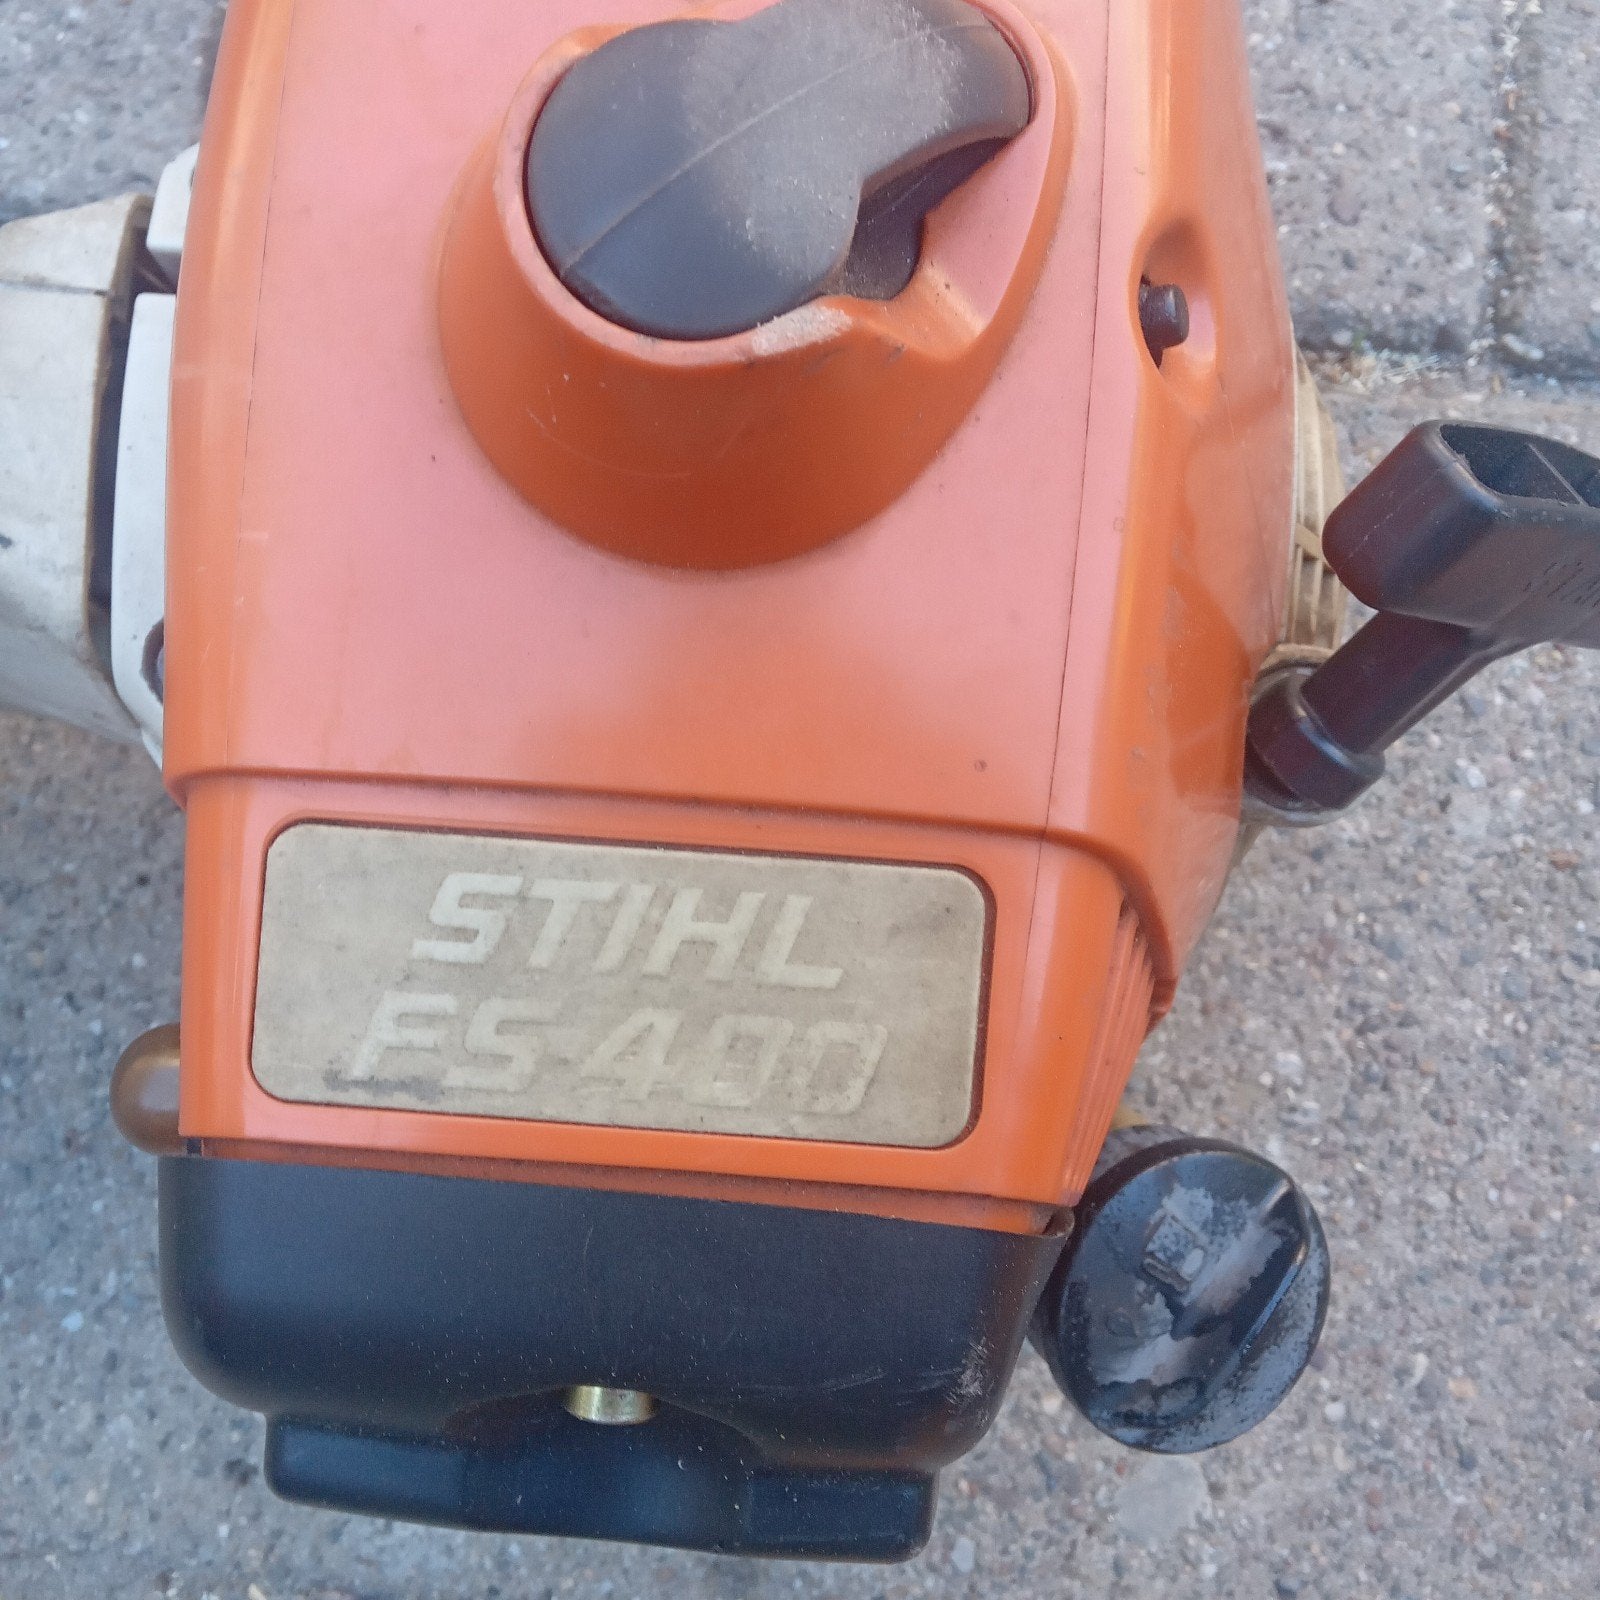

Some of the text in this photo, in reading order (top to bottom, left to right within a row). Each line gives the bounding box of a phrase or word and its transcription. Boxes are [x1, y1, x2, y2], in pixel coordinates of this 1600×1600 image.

[410, 871, 845, 991] STIHL
[346, 990, 888, 1115] FS 400
